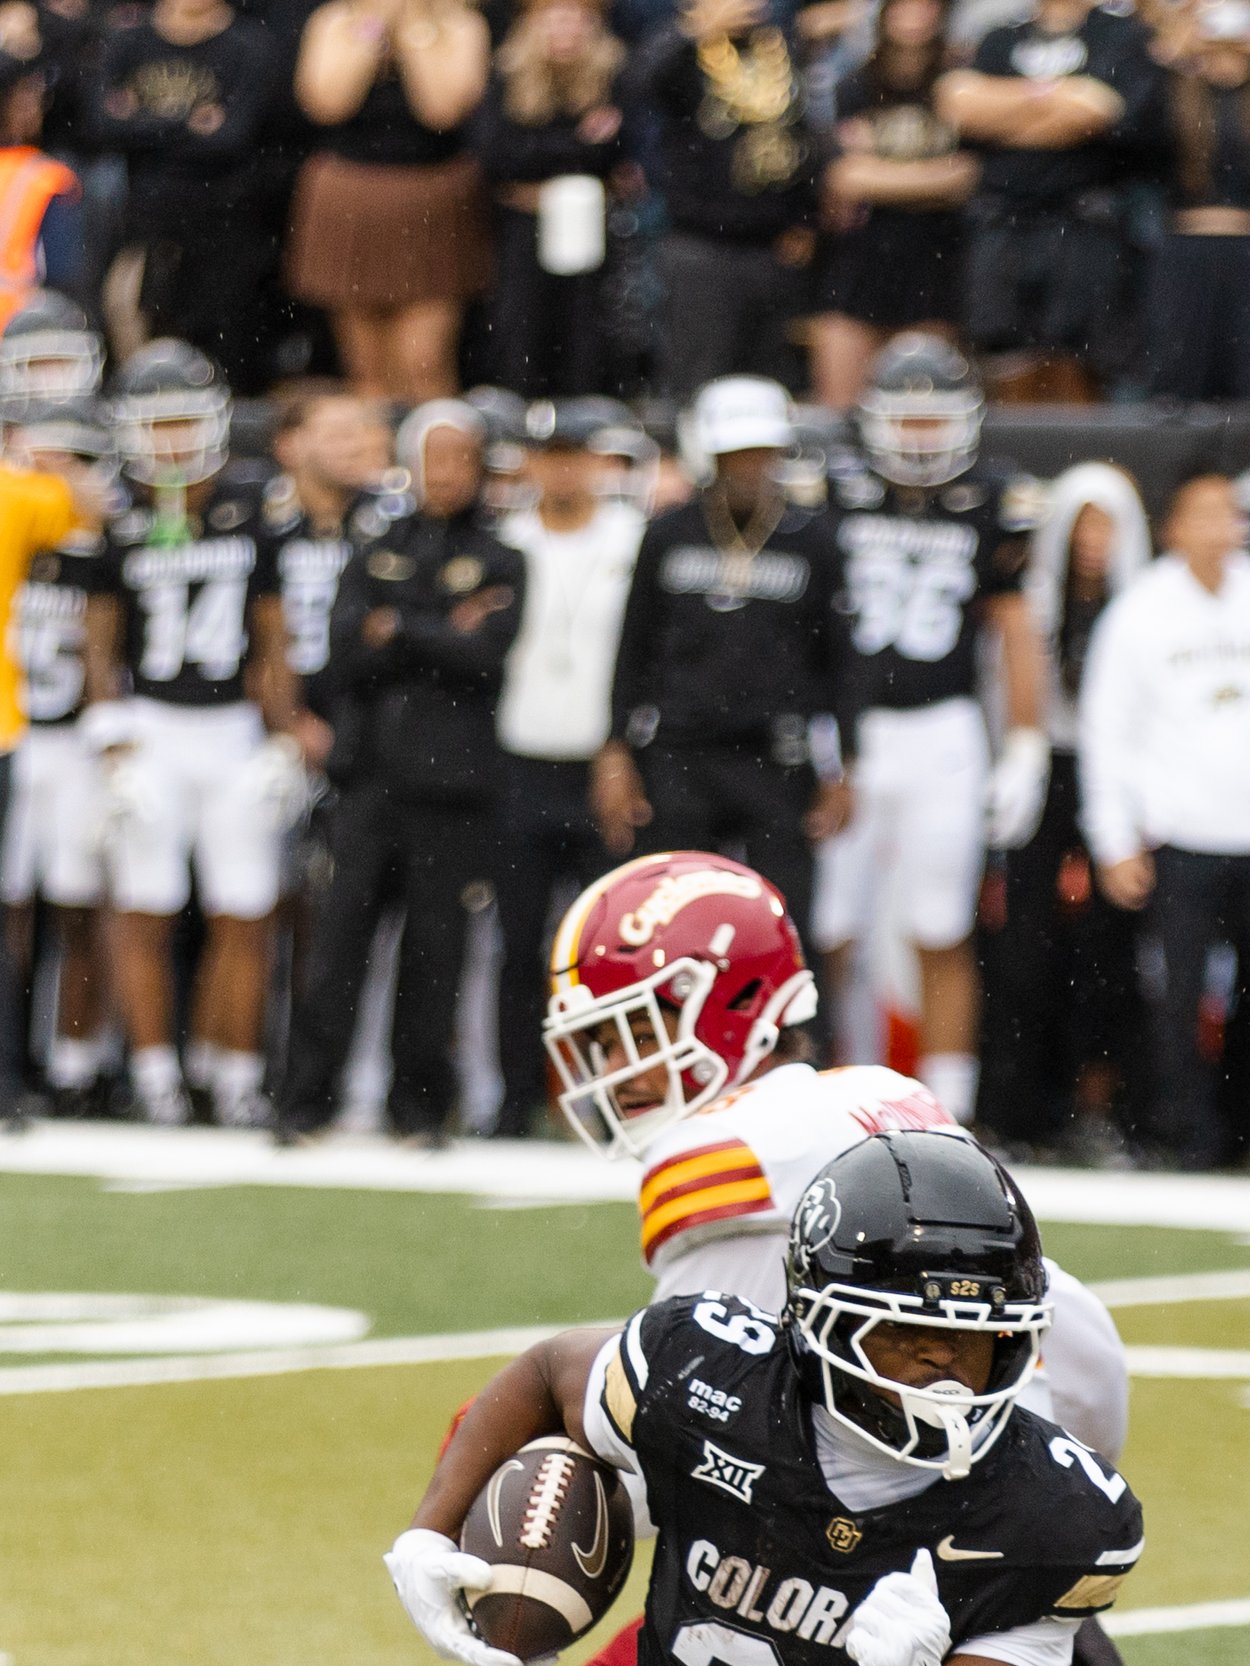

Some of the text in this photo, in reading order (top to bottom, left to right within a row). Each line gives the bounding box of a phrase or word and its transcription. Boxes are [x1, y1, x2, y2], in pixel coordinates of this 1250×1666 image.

[687, 1396, 730, 1423] 82-94
[688, 1379, 742, 1412] mac
[686, 1539, 855, 1649] COLOR
